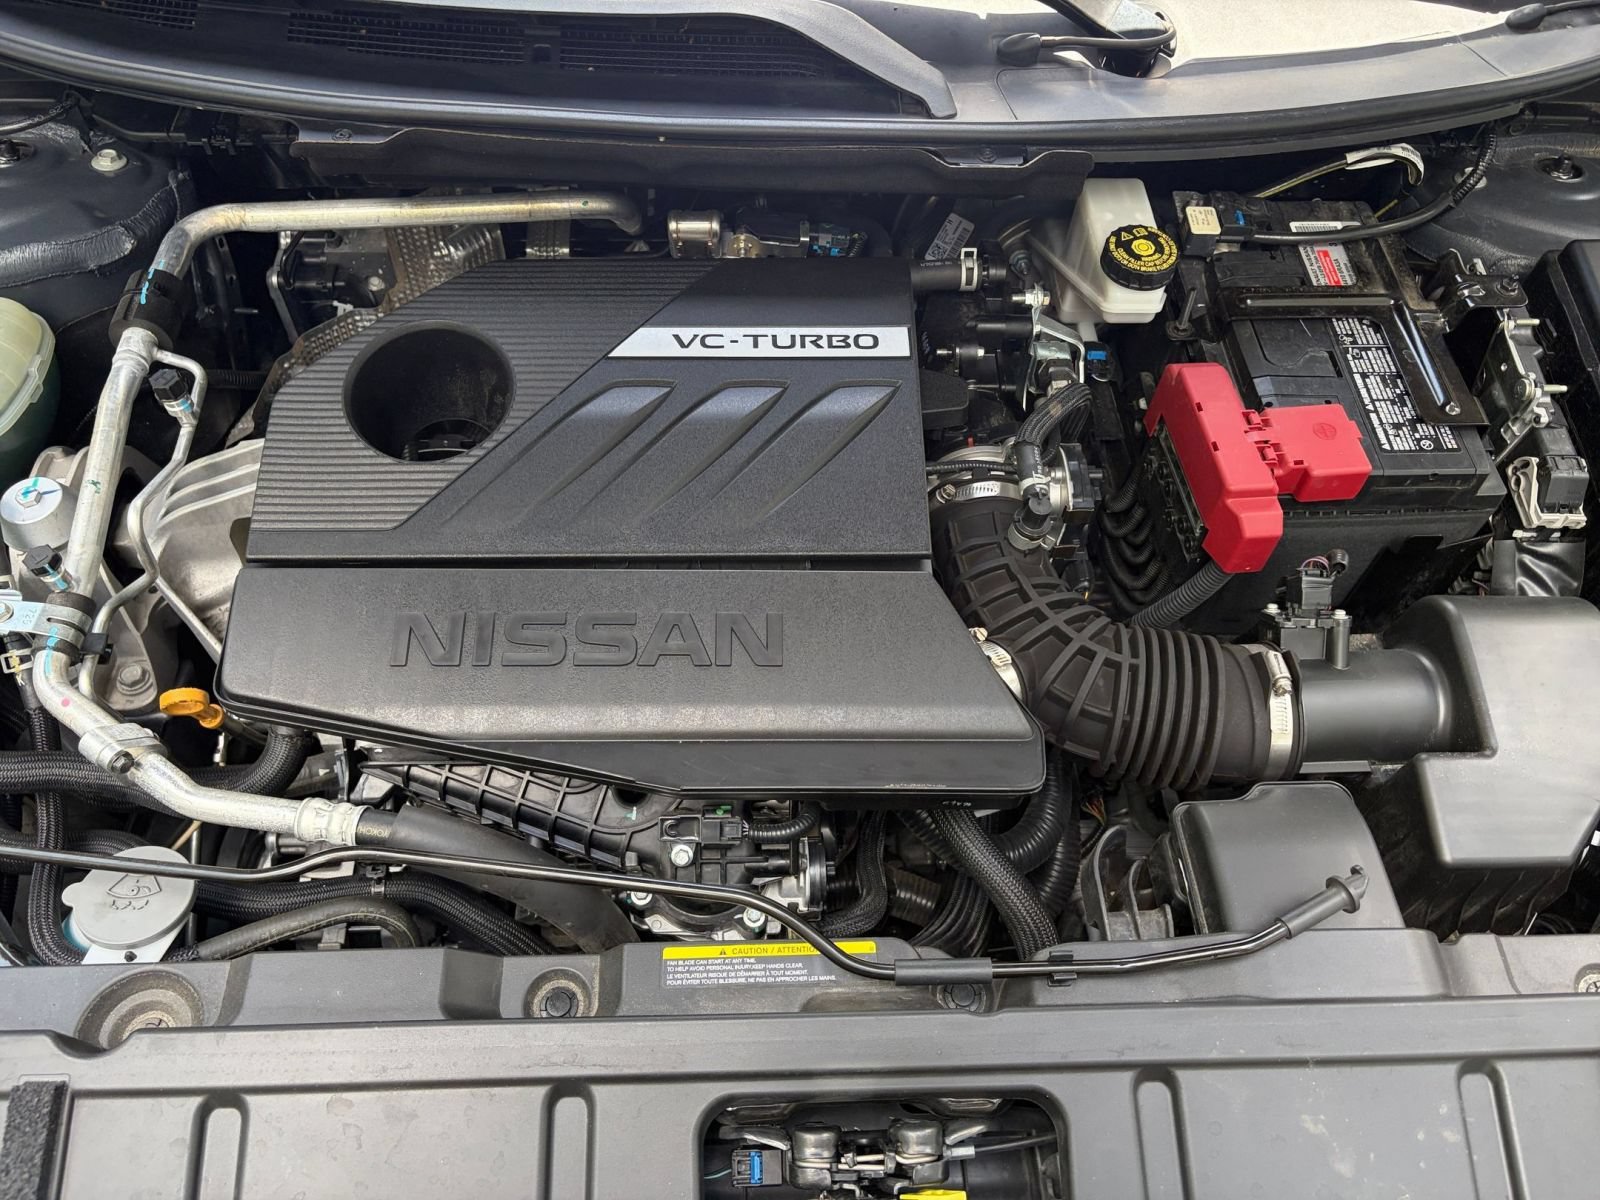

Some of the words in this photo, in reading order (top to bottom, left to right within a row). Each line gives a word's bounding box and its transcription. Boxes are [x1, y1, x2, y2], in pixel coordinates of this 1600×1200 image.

[1117, 247, 1130, 260] CLEAN
[1128, 257, 1145, 266] FILLER
[671, 333, 880, 350] VC-TURBO
[390, 611, 784, 668] NISSAN
[731, 947, 768, 955] CAUTION
[736, 969, 765, 977] DÉMARRER
[683, 978, 701, 986] ÉVITER
